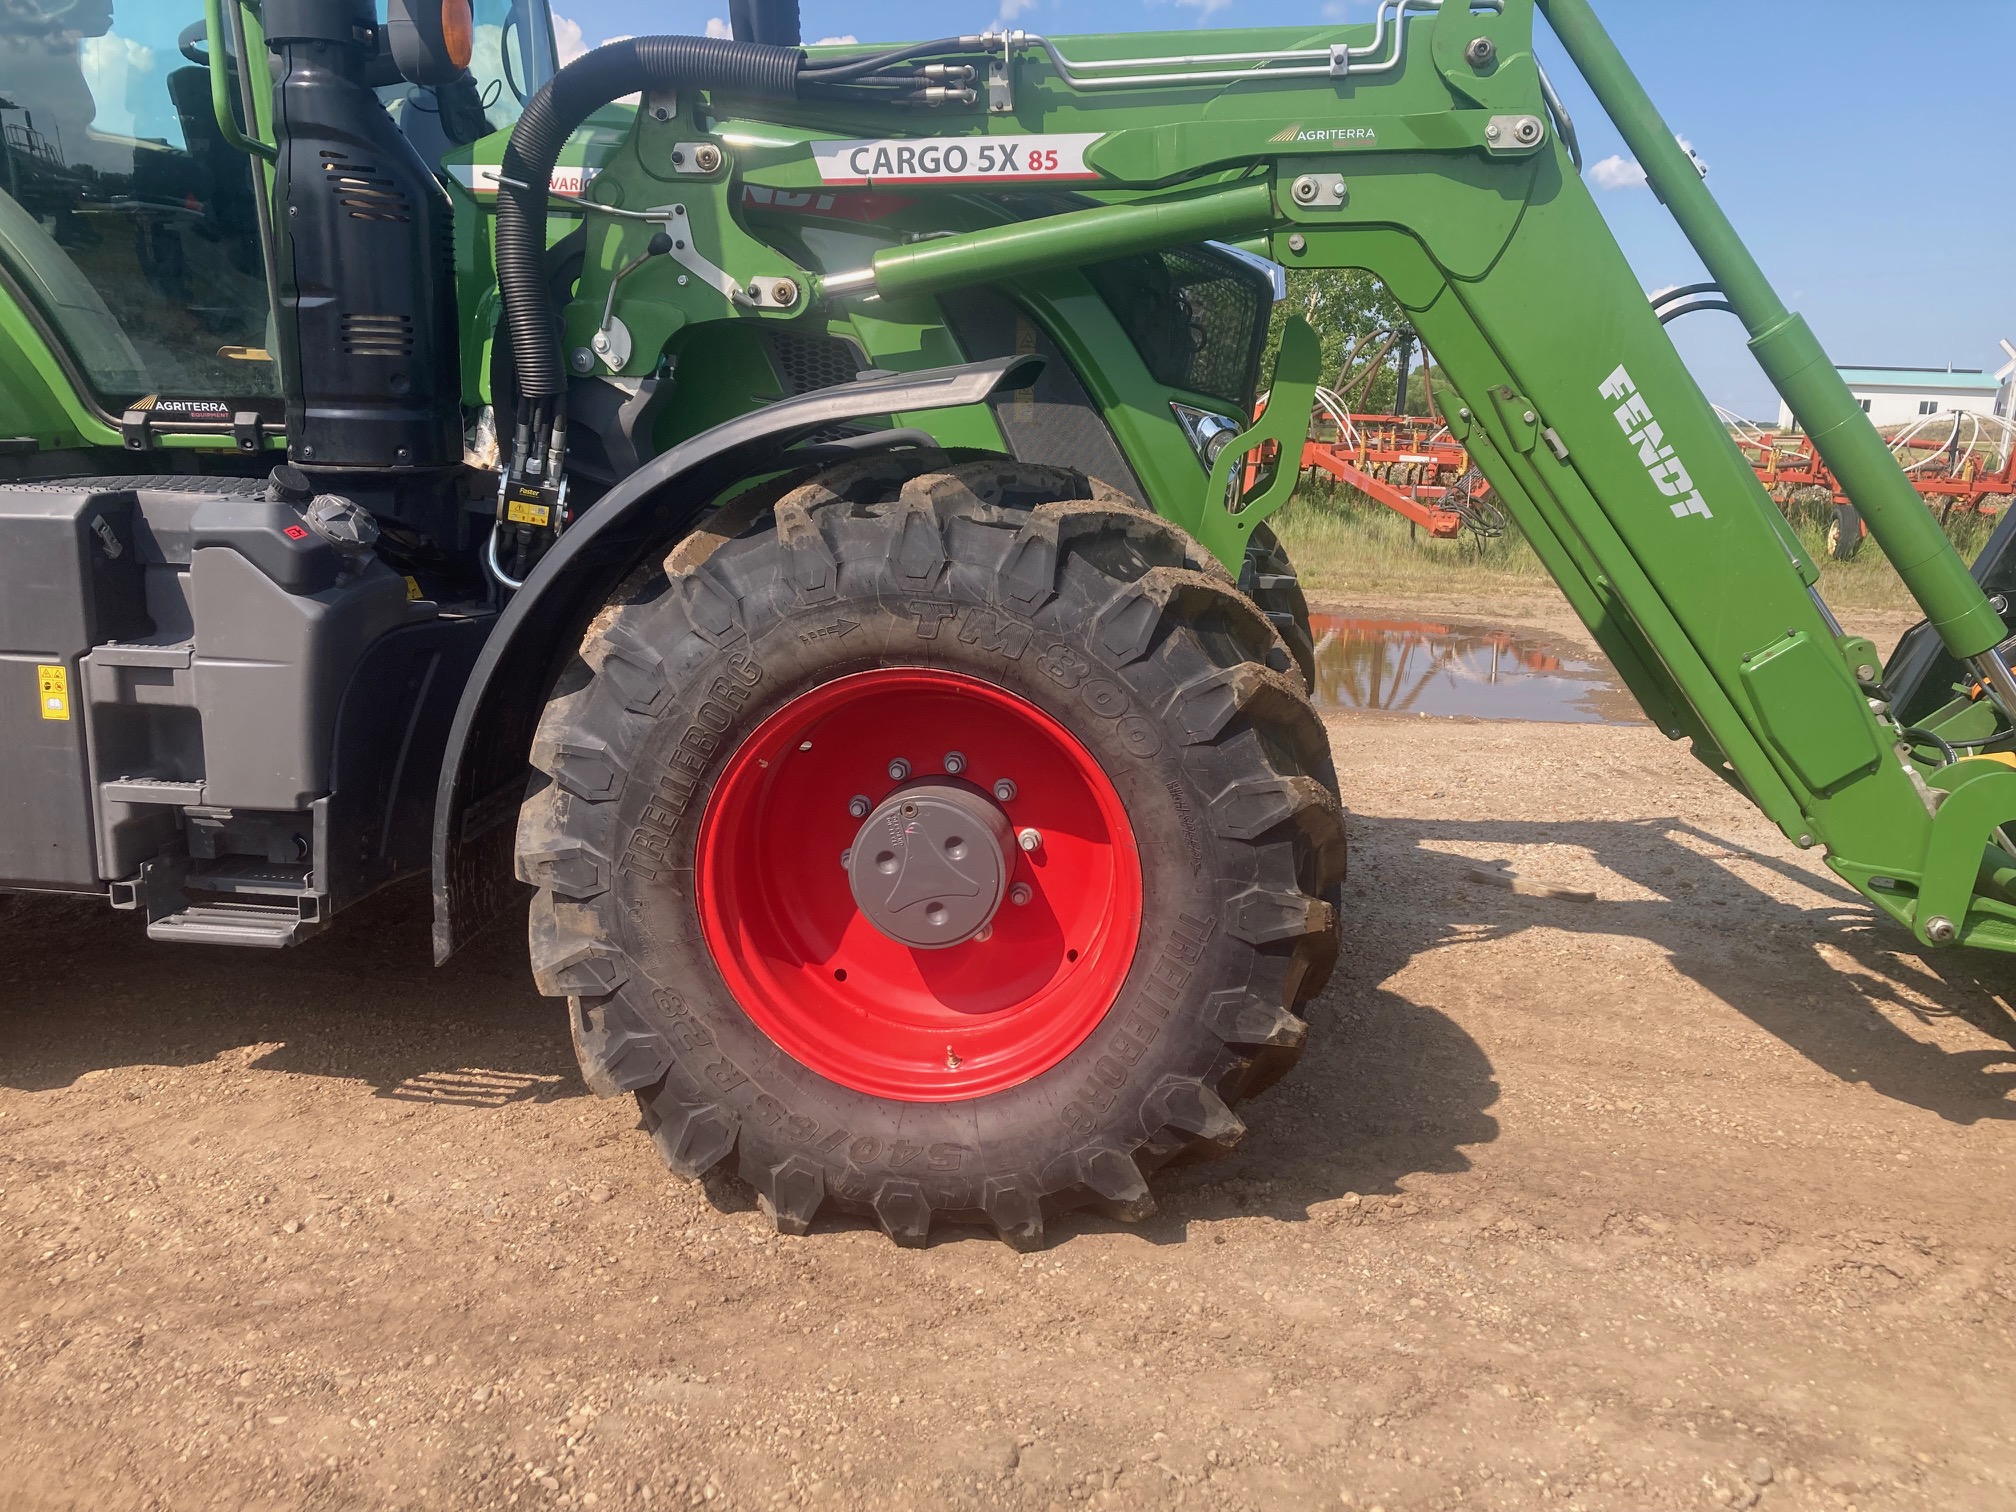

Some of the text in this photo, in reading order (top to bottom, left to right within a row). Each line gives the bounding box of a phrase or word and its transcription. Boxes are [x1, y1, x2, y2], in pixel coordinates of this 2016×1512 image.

[850, 144, 1058, 175] CARGO 5X 85
[1297, 128, 1375, 141] AGRITERRA
[155, 402, 229, 412] AGRITERRA
[1598, 363, 1713, 519] FENDT
[520, 487, 540, 497] Faster
[908, 600, 1163, 760] TM 800
[618, 650, 763, 881] TRELLEBORG
[1060, 912, 1218, 1136] TRELLEBORG
